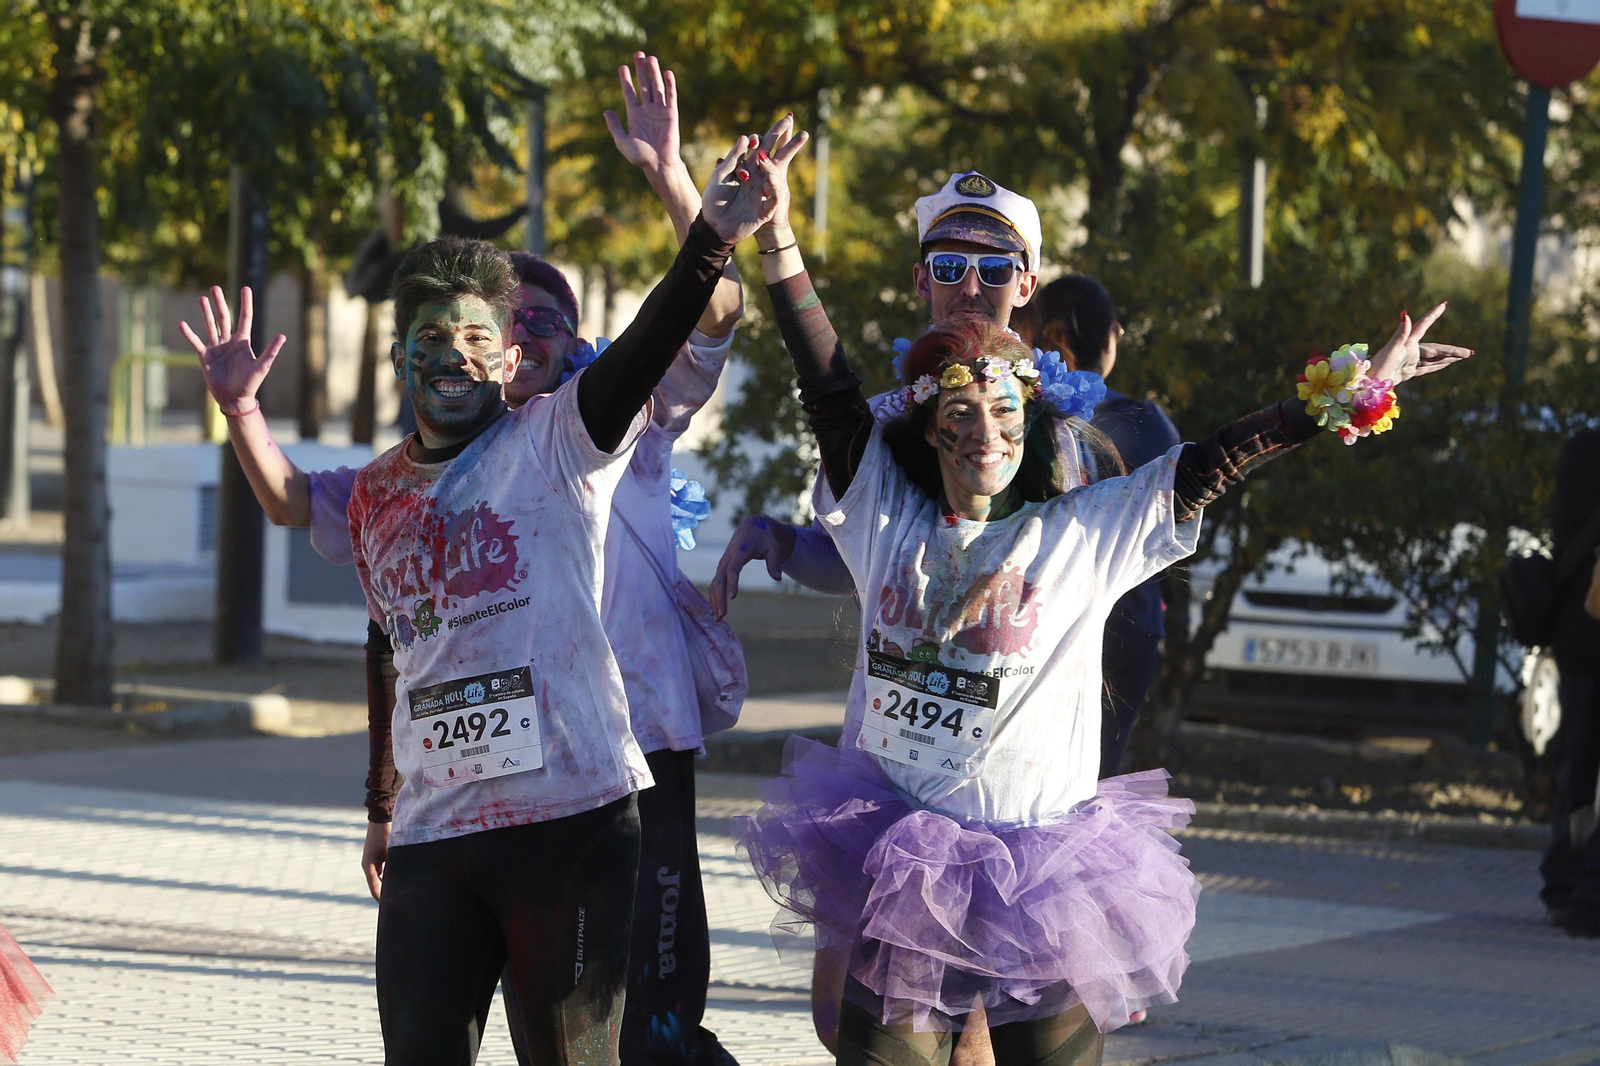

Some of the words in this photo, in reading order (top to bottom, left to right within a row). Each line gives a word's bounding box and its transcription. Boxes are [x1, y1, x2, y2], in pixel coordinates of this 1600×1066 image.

[445, 518, 509, 581] Life
[448, 596, 531, 630] #SienteElColor
[871, 662, 907, 679] GRANADA
[908, 670, 926, 686] HOLI
[929, 676, 947, 689] Life
[413, 698, 445, 713] GRANADA
[445, 691, 464, 705] HOLI
[467, 686, 484, 697] Life
[884, 689, 965, 737] 2494
[432, 708, 511, 749] 2492
[909, 749, 919, 760] 20
[576, 906, 586, 961] OUTPACE
[657, 866, 681, 979] Joma
